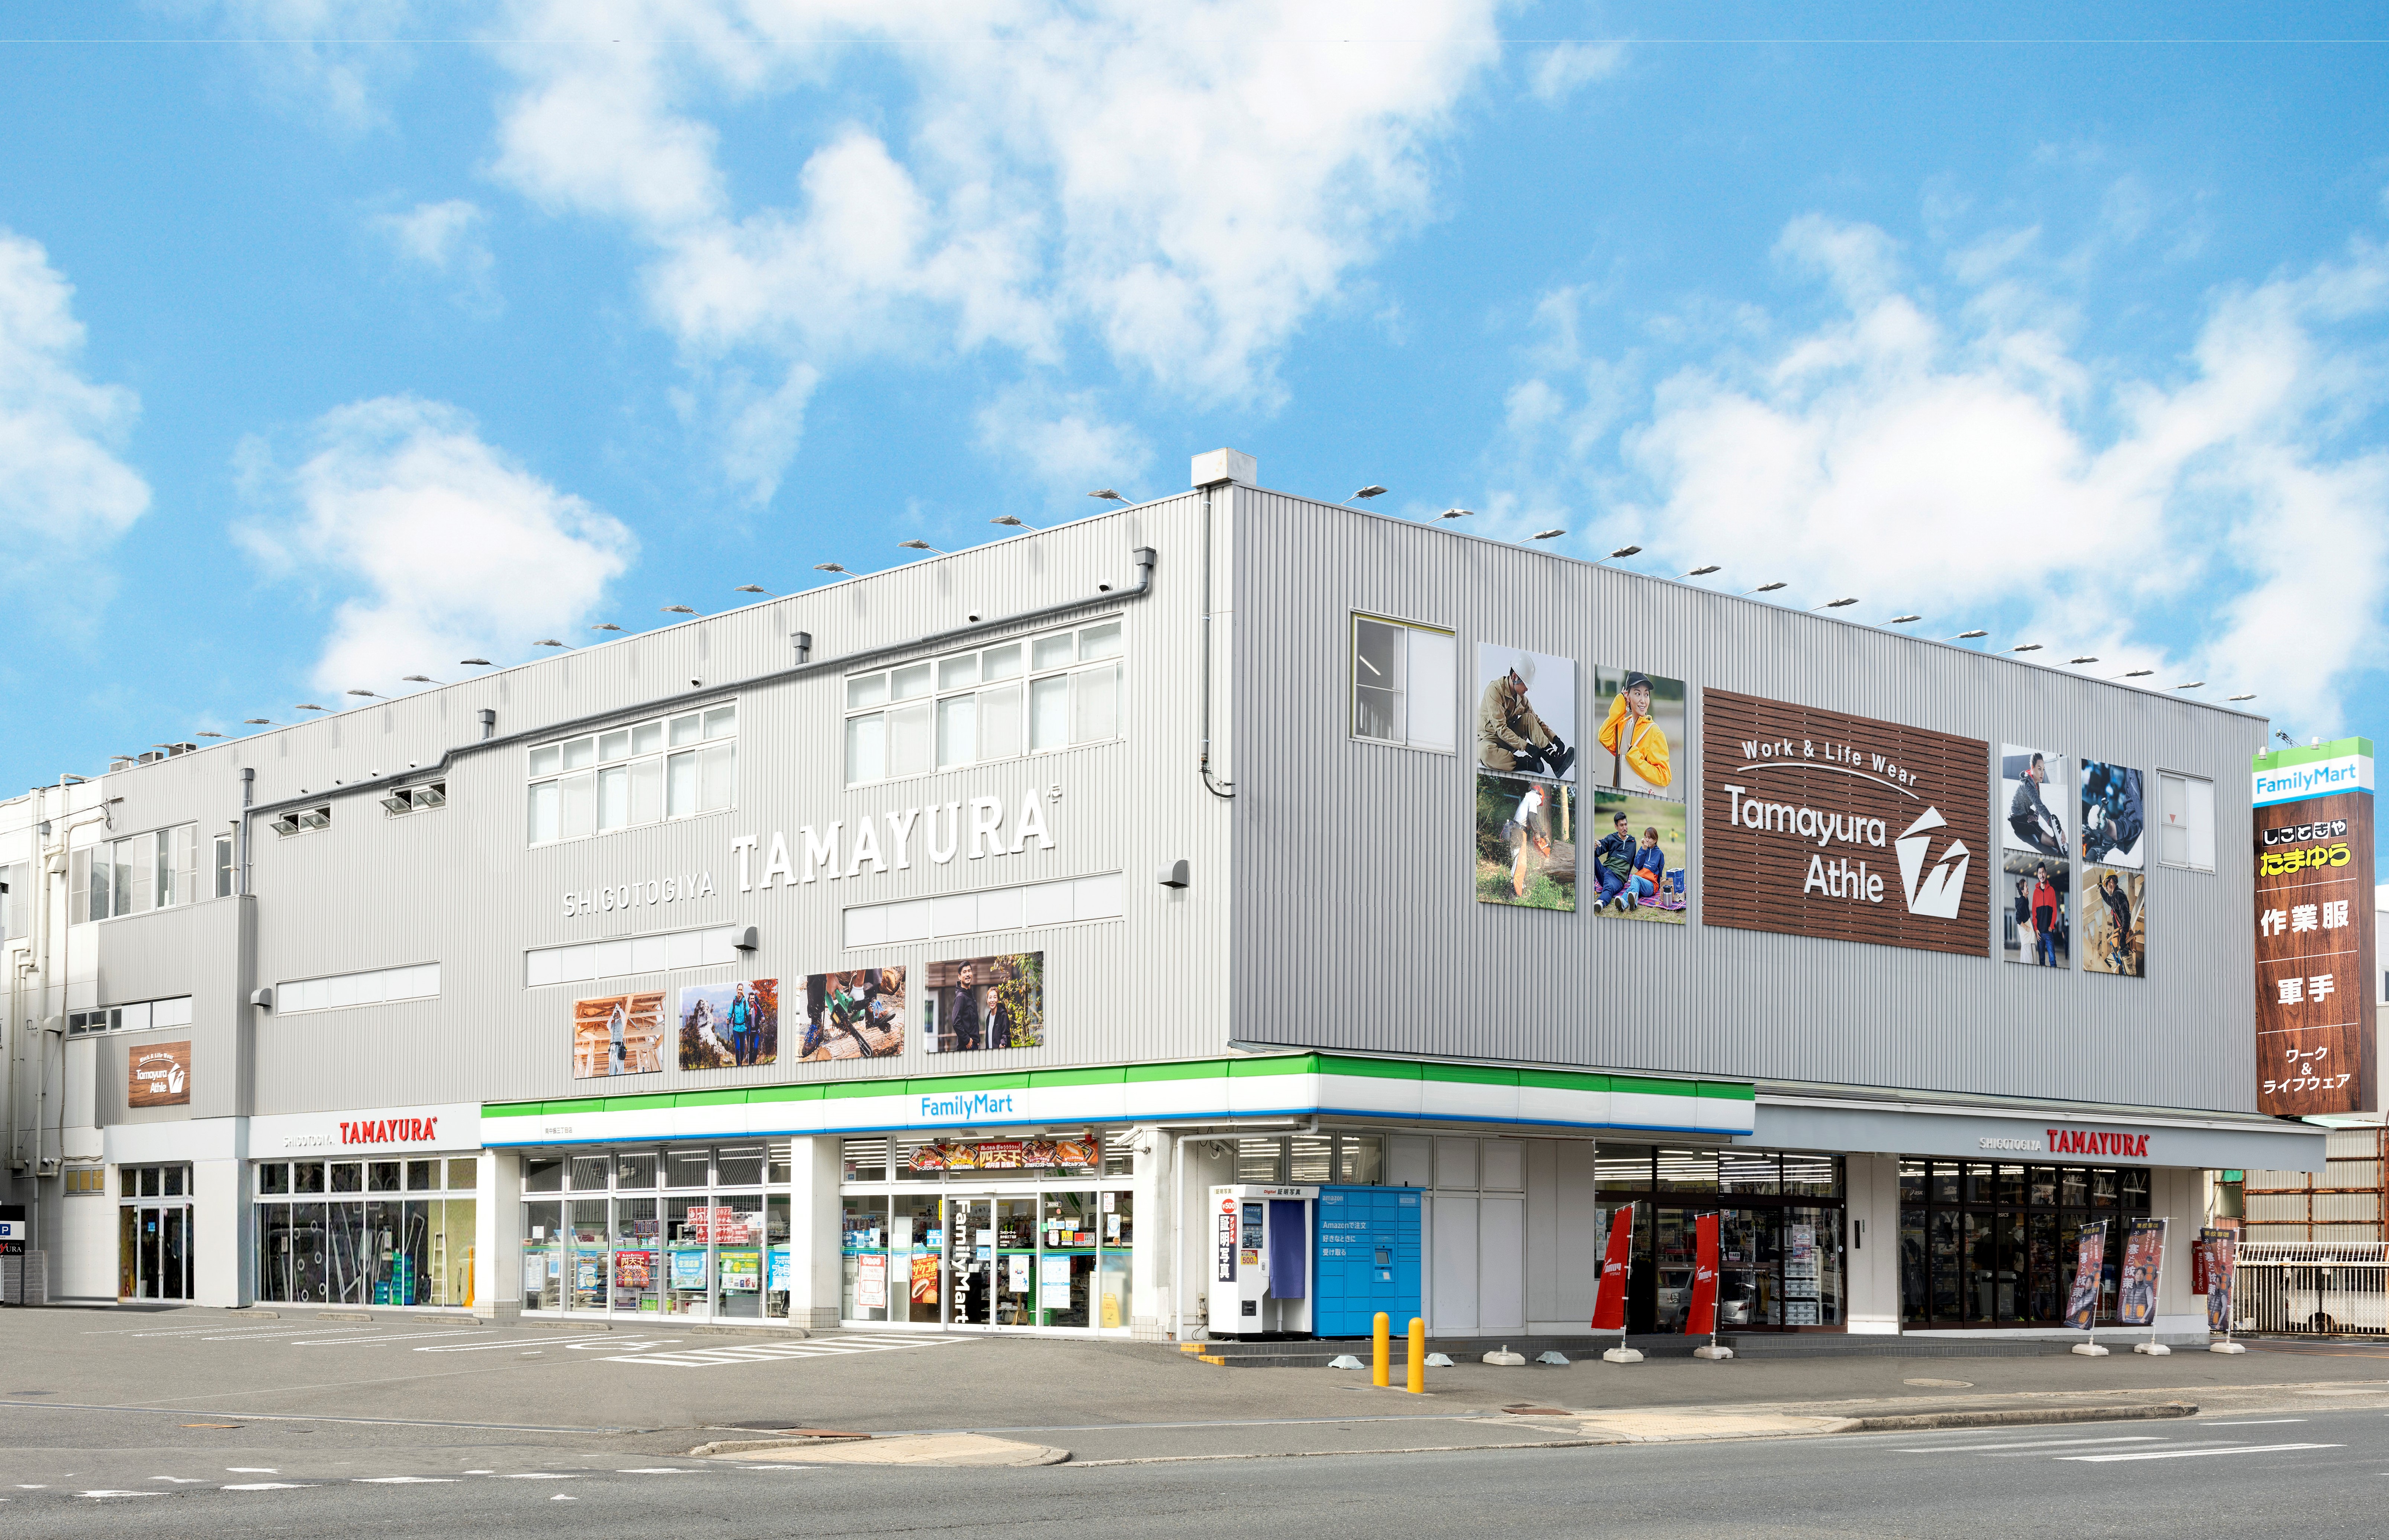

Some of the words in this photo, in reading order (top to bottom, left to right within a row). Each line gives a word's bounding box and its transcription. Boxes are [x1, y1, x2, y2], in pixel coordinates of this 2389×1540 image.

[1742, 739, 1793, 759] Work
[1804, 740, 1814, 757] &
[1826, 742, 1861, 765] Life
[1872, 753, 1916, 787] Wear
[2257, 764, 2356, 794] FamilyMart
[1724, 784, 1886, 846] Tamayura
[2264, 820, 2346, 845] しごとぎや
[563, 872, 716, 917] SHIGOTOGIYA
[732, 788, 1055, 892] TAMAYURA
[2260, 842, 2351, 877] たまゆら
[1804, 855, 1884, 902] Athle
[2261, 900, 2348, 936] 作業服
[2278, 974, 2334, 1004] 軍手
[2286, 1046, 2327, 1063] ワーク
[2301, 1062, 2312, 1075] &
[136, 1069, 167, 1081] Tamayura
[150, 1082, 167, 1093] Athle
[2264, 1073, 2350, 1094] ライフウェア
[922, 1094, 1013, 1119] FamilyMart
[283, 1134, 335, 1147] SHIGOTOGIYA
[340, 1118, 435, 1144] TAMAYURA
[1979, 1137, 2042, 1151] SHIGOTOGIYA
[2047, 1129, 2148, 1157] TAMAYURA
[980, 1149, 1022, 1169] 四天王
[952, 1200, 970, 1323] FamilyMart
[1220, 1216, 1229, 1279] 証明写真
[912, 1261, 937, 1275] ザクうま
